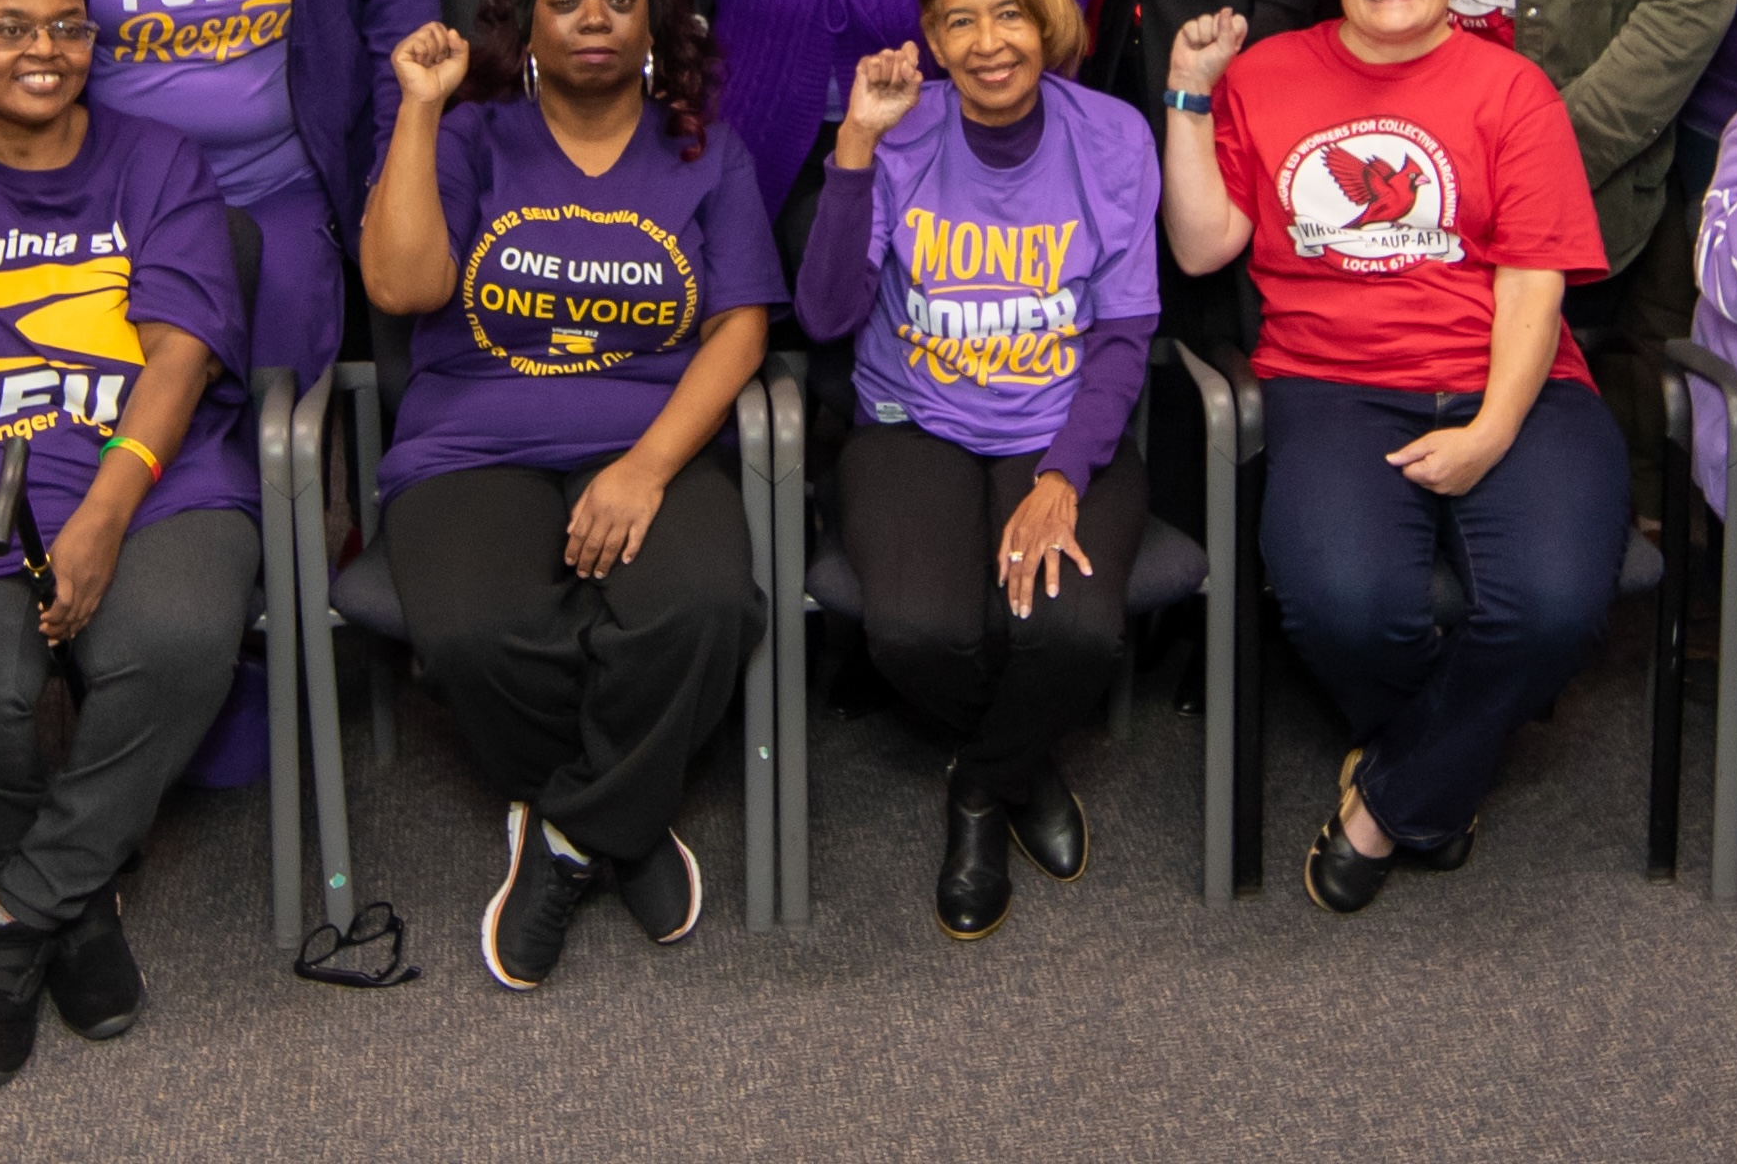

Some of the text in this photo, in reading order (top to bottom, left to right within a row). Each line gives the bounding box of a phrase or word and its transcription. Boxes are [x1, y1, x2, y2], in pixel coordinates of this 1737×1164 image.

[1287, 151, 1300, 171] ED
[1299, 125, 1350, 156] WORKERS
[1351, 120, 1377, 134] FOR
[1378, 118, 1437, 154] COLLECTIVE
[1433, 148, 1458, 228] BARGAINING
[499, 246, 664, 286] ONE UNION
[905, 206, 1079, 294] MONEY
[1342, 255, 1387, 273] LOCAL
[463, 203, 698, 347] VIRGINIA 512 SEIU VIRGINIA 512 SEIU VIRGINIA
[480, 283, 678, 326] ONE VOICE
[907, 287, 1078, 340] POWER
[466, 313, 493, 350] SEIU
[584, 329, 599, 338] 512
